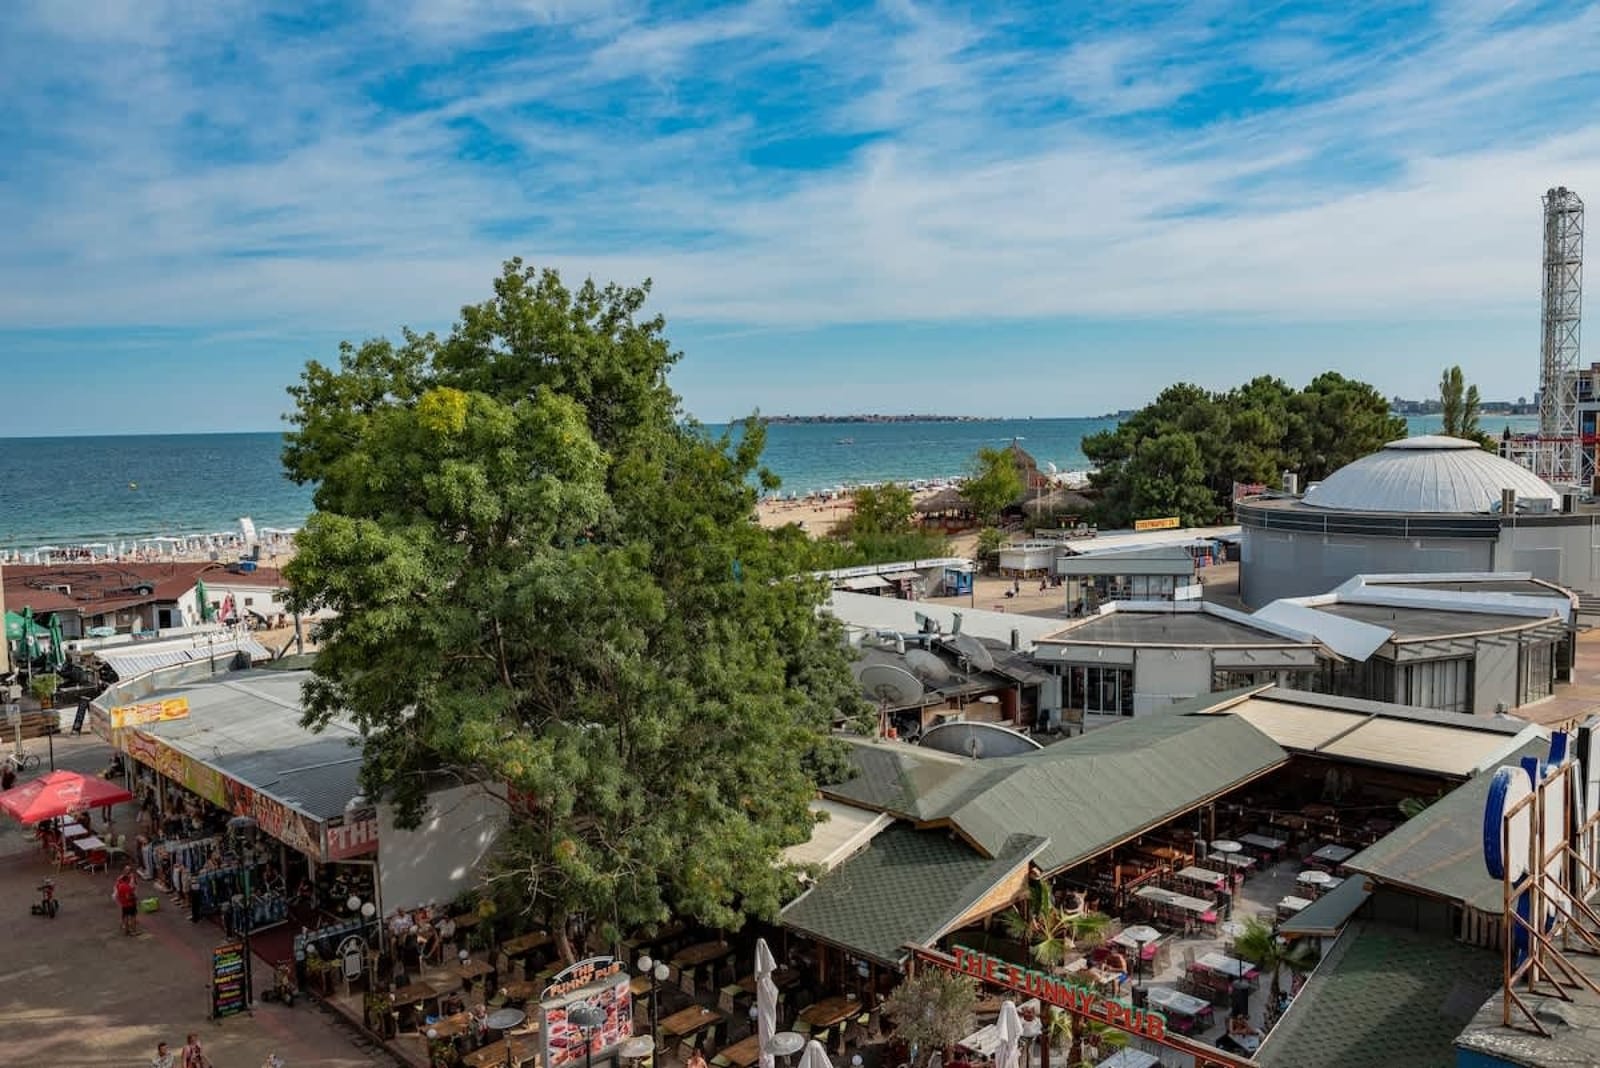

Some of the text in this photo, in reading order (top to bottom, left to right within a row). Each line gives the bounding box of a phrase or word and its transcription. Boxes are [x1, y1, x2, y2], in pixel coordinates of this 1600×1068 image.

[572, 963, 595, 978] THE
[595, 962, 620, 981] PUB
[952, 944, 1167, 1042] THE FUNNY PUB
